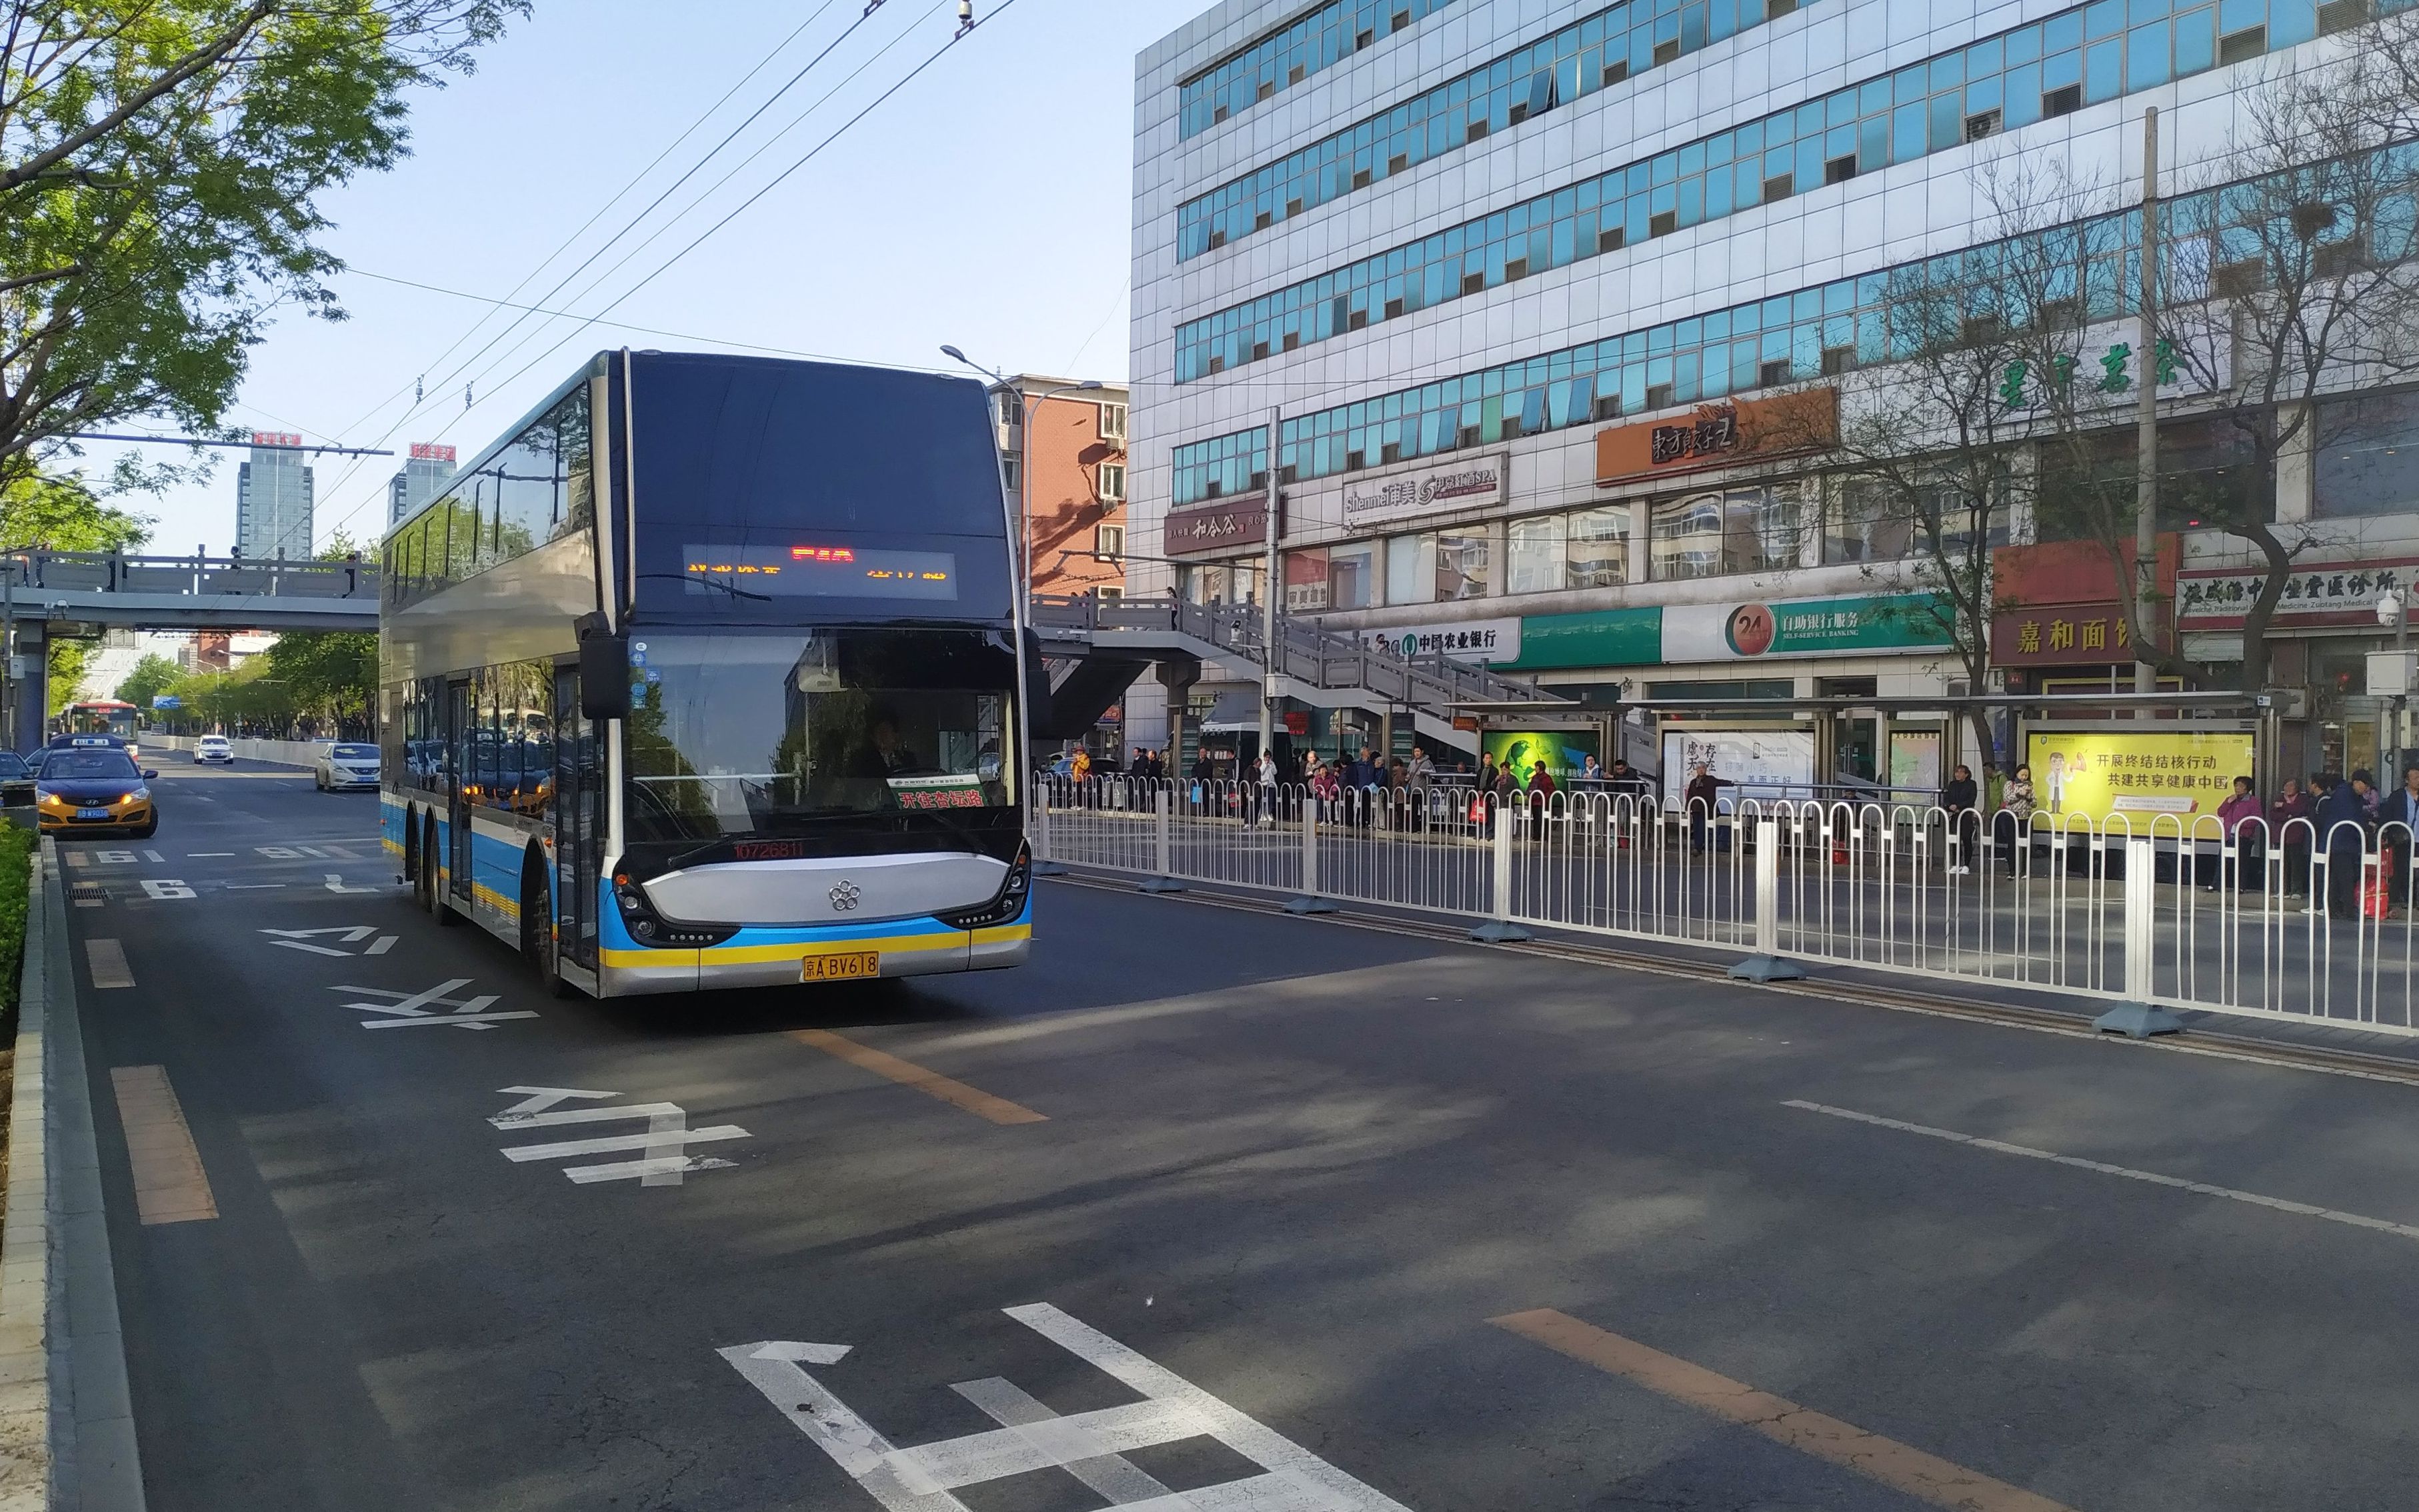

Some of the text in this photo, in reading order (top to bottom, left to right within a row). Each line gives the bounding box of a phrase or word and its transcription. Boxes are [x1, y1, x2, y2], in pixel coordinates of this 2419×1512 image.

[1346, 486, 1390, 512] Shenmei
[1389, 481, 1416, 505] 审美
[1192, 514, 1236, 539] 和合谷
[1248, 513, 1268, 525] 良心品
[2184, 571, 2396, 603] 德威治中坐堂医诊所
[2277, 601, 2308, 609] Medicine
[2311, 600, 2342, 609] Zuotang
[2344, 599, 2373, 607] Medical
[1739, 615, 1762, 634] 24
[1783, 611, 1859, 631] 自助银行服务
[1419, 629, 1496, 651] 中国农业银行
[1829, 629, 1859, 637] BANKING
[2096, 754, 2217, 770] 开展终结结核行动
[2108, 773, 2228, 789] 共建共享健康中国
[898, 789, 984, 809] 开往杏坛路
